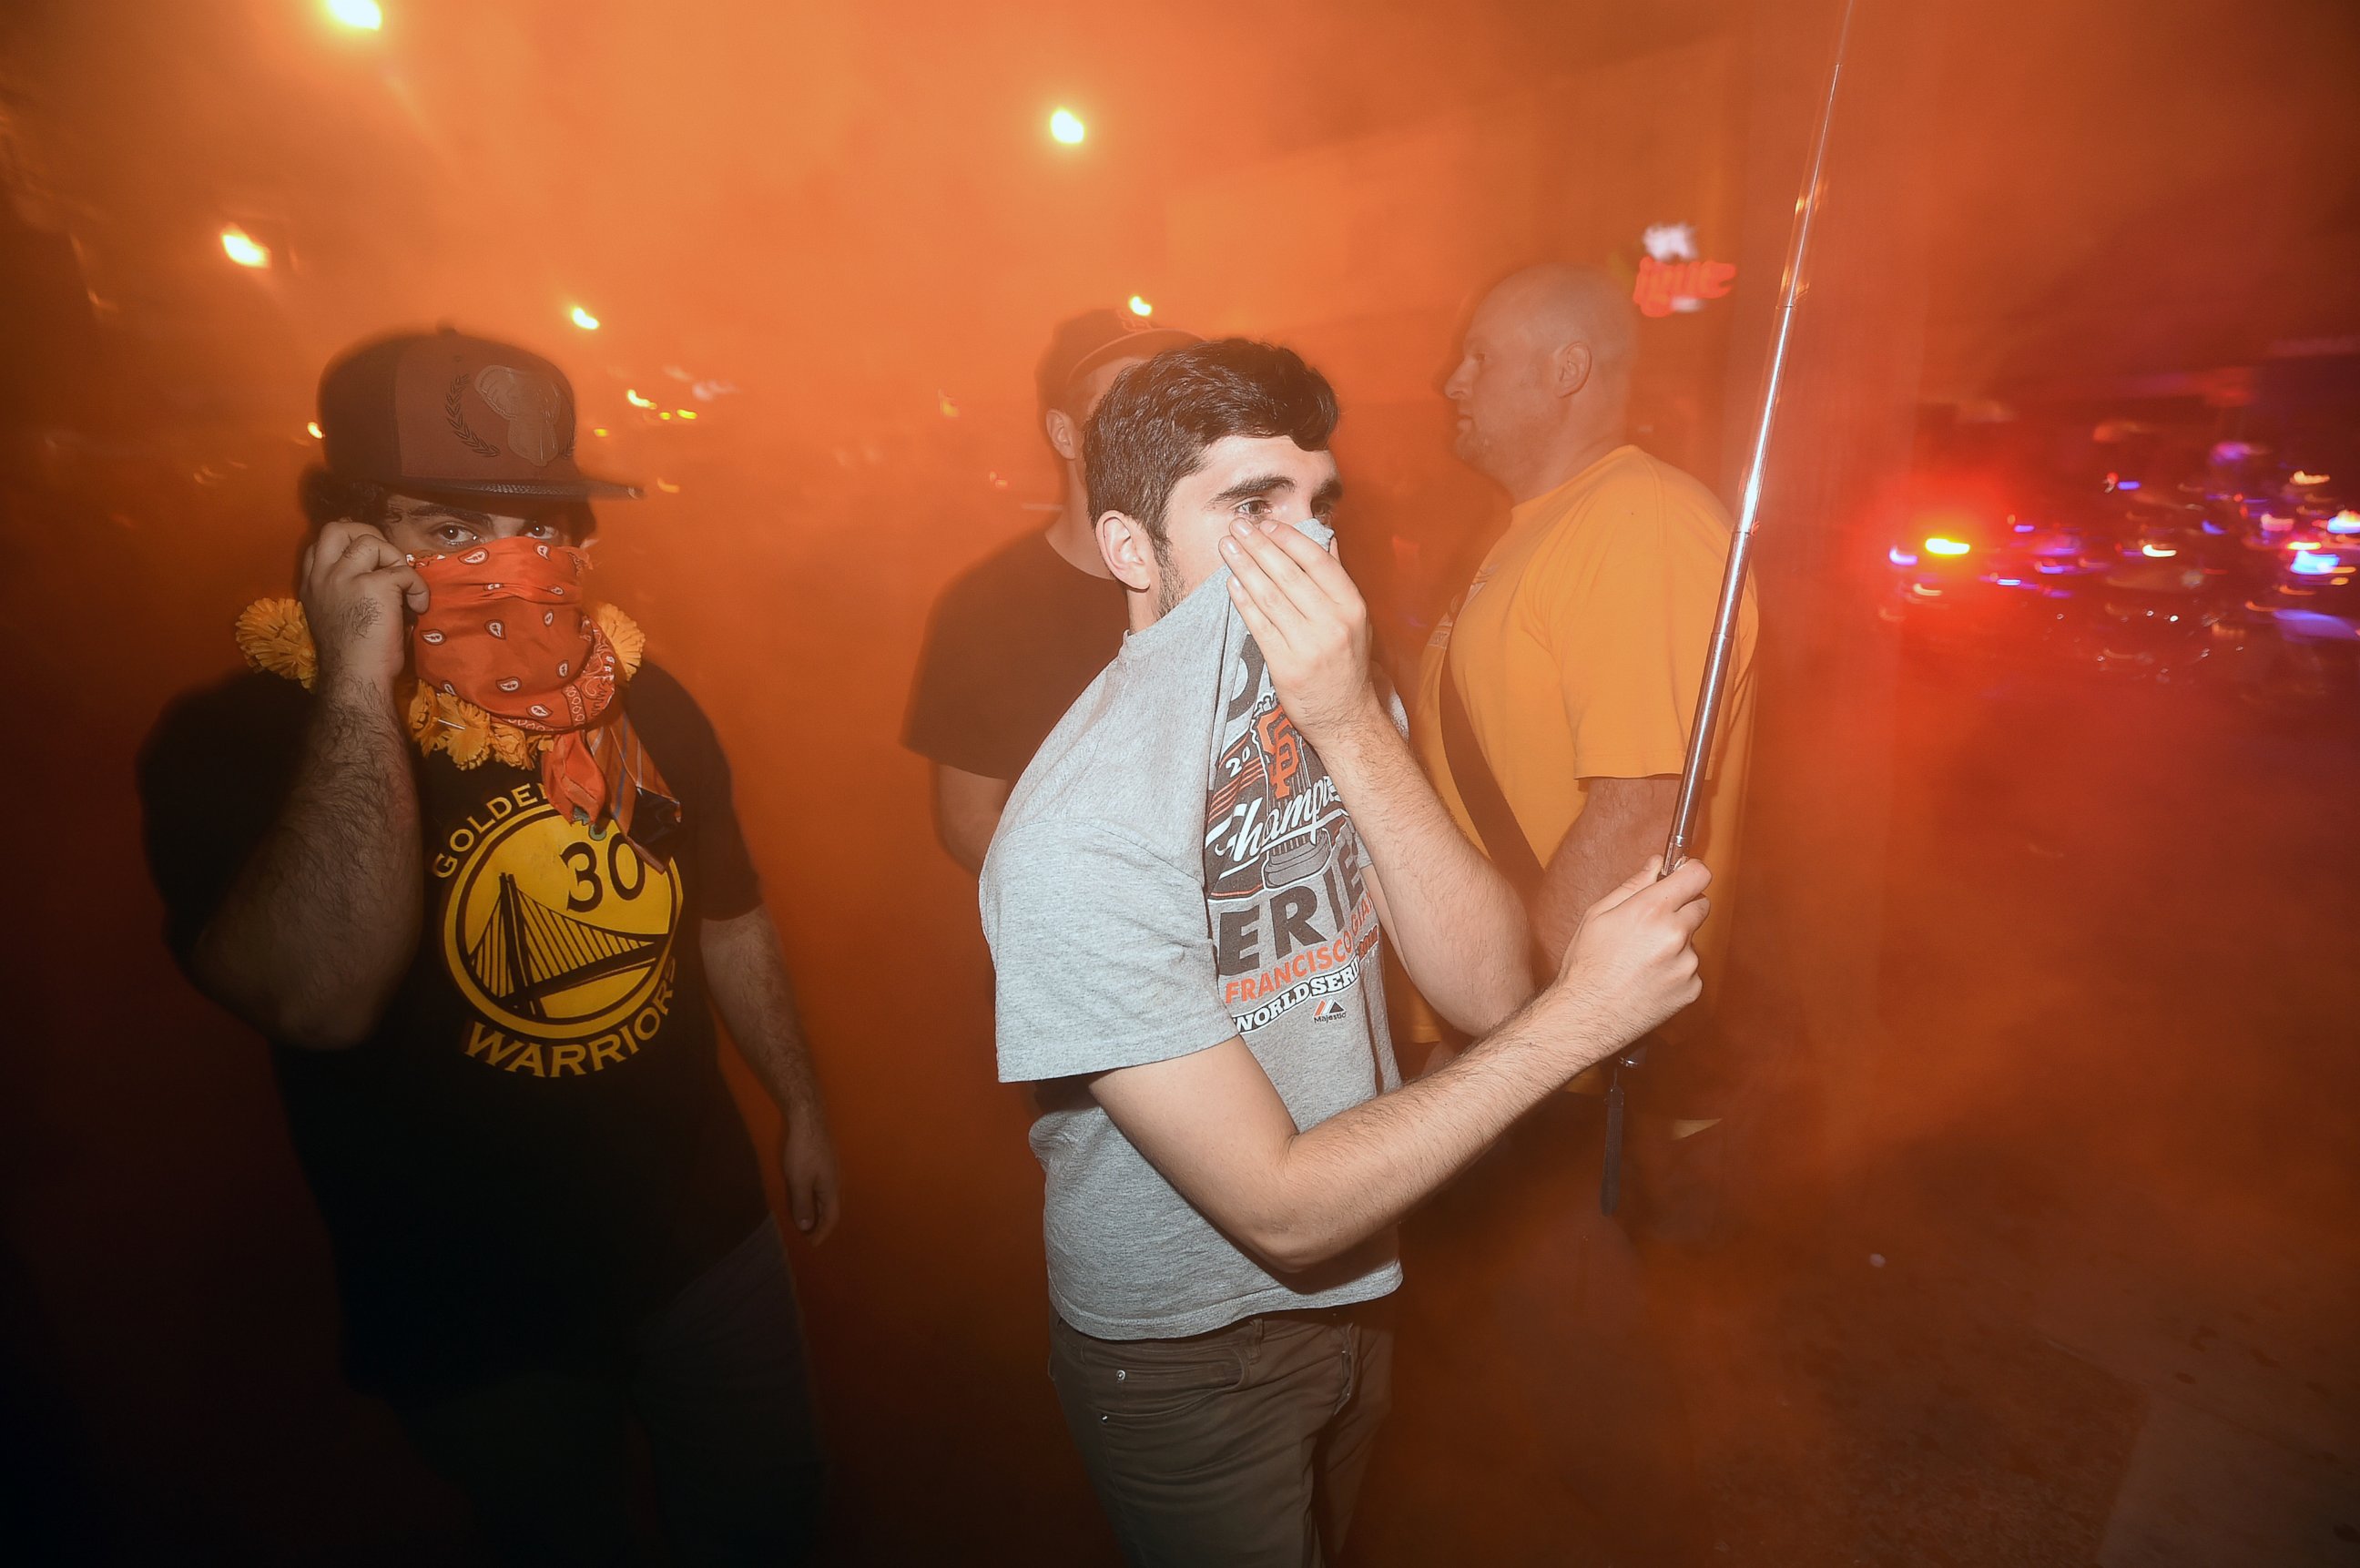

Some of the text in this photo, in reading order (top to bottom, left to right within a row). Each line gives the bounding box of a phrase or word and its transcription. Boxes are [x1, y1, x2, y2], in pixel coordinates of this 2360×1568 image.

[559, 832, 645, 912] 30
[1219, 833, 1364, 976] ERIE
[1226, 930, 1354, 1004] FRANCISCO
[1351, 891, 1374, 937] GIA
